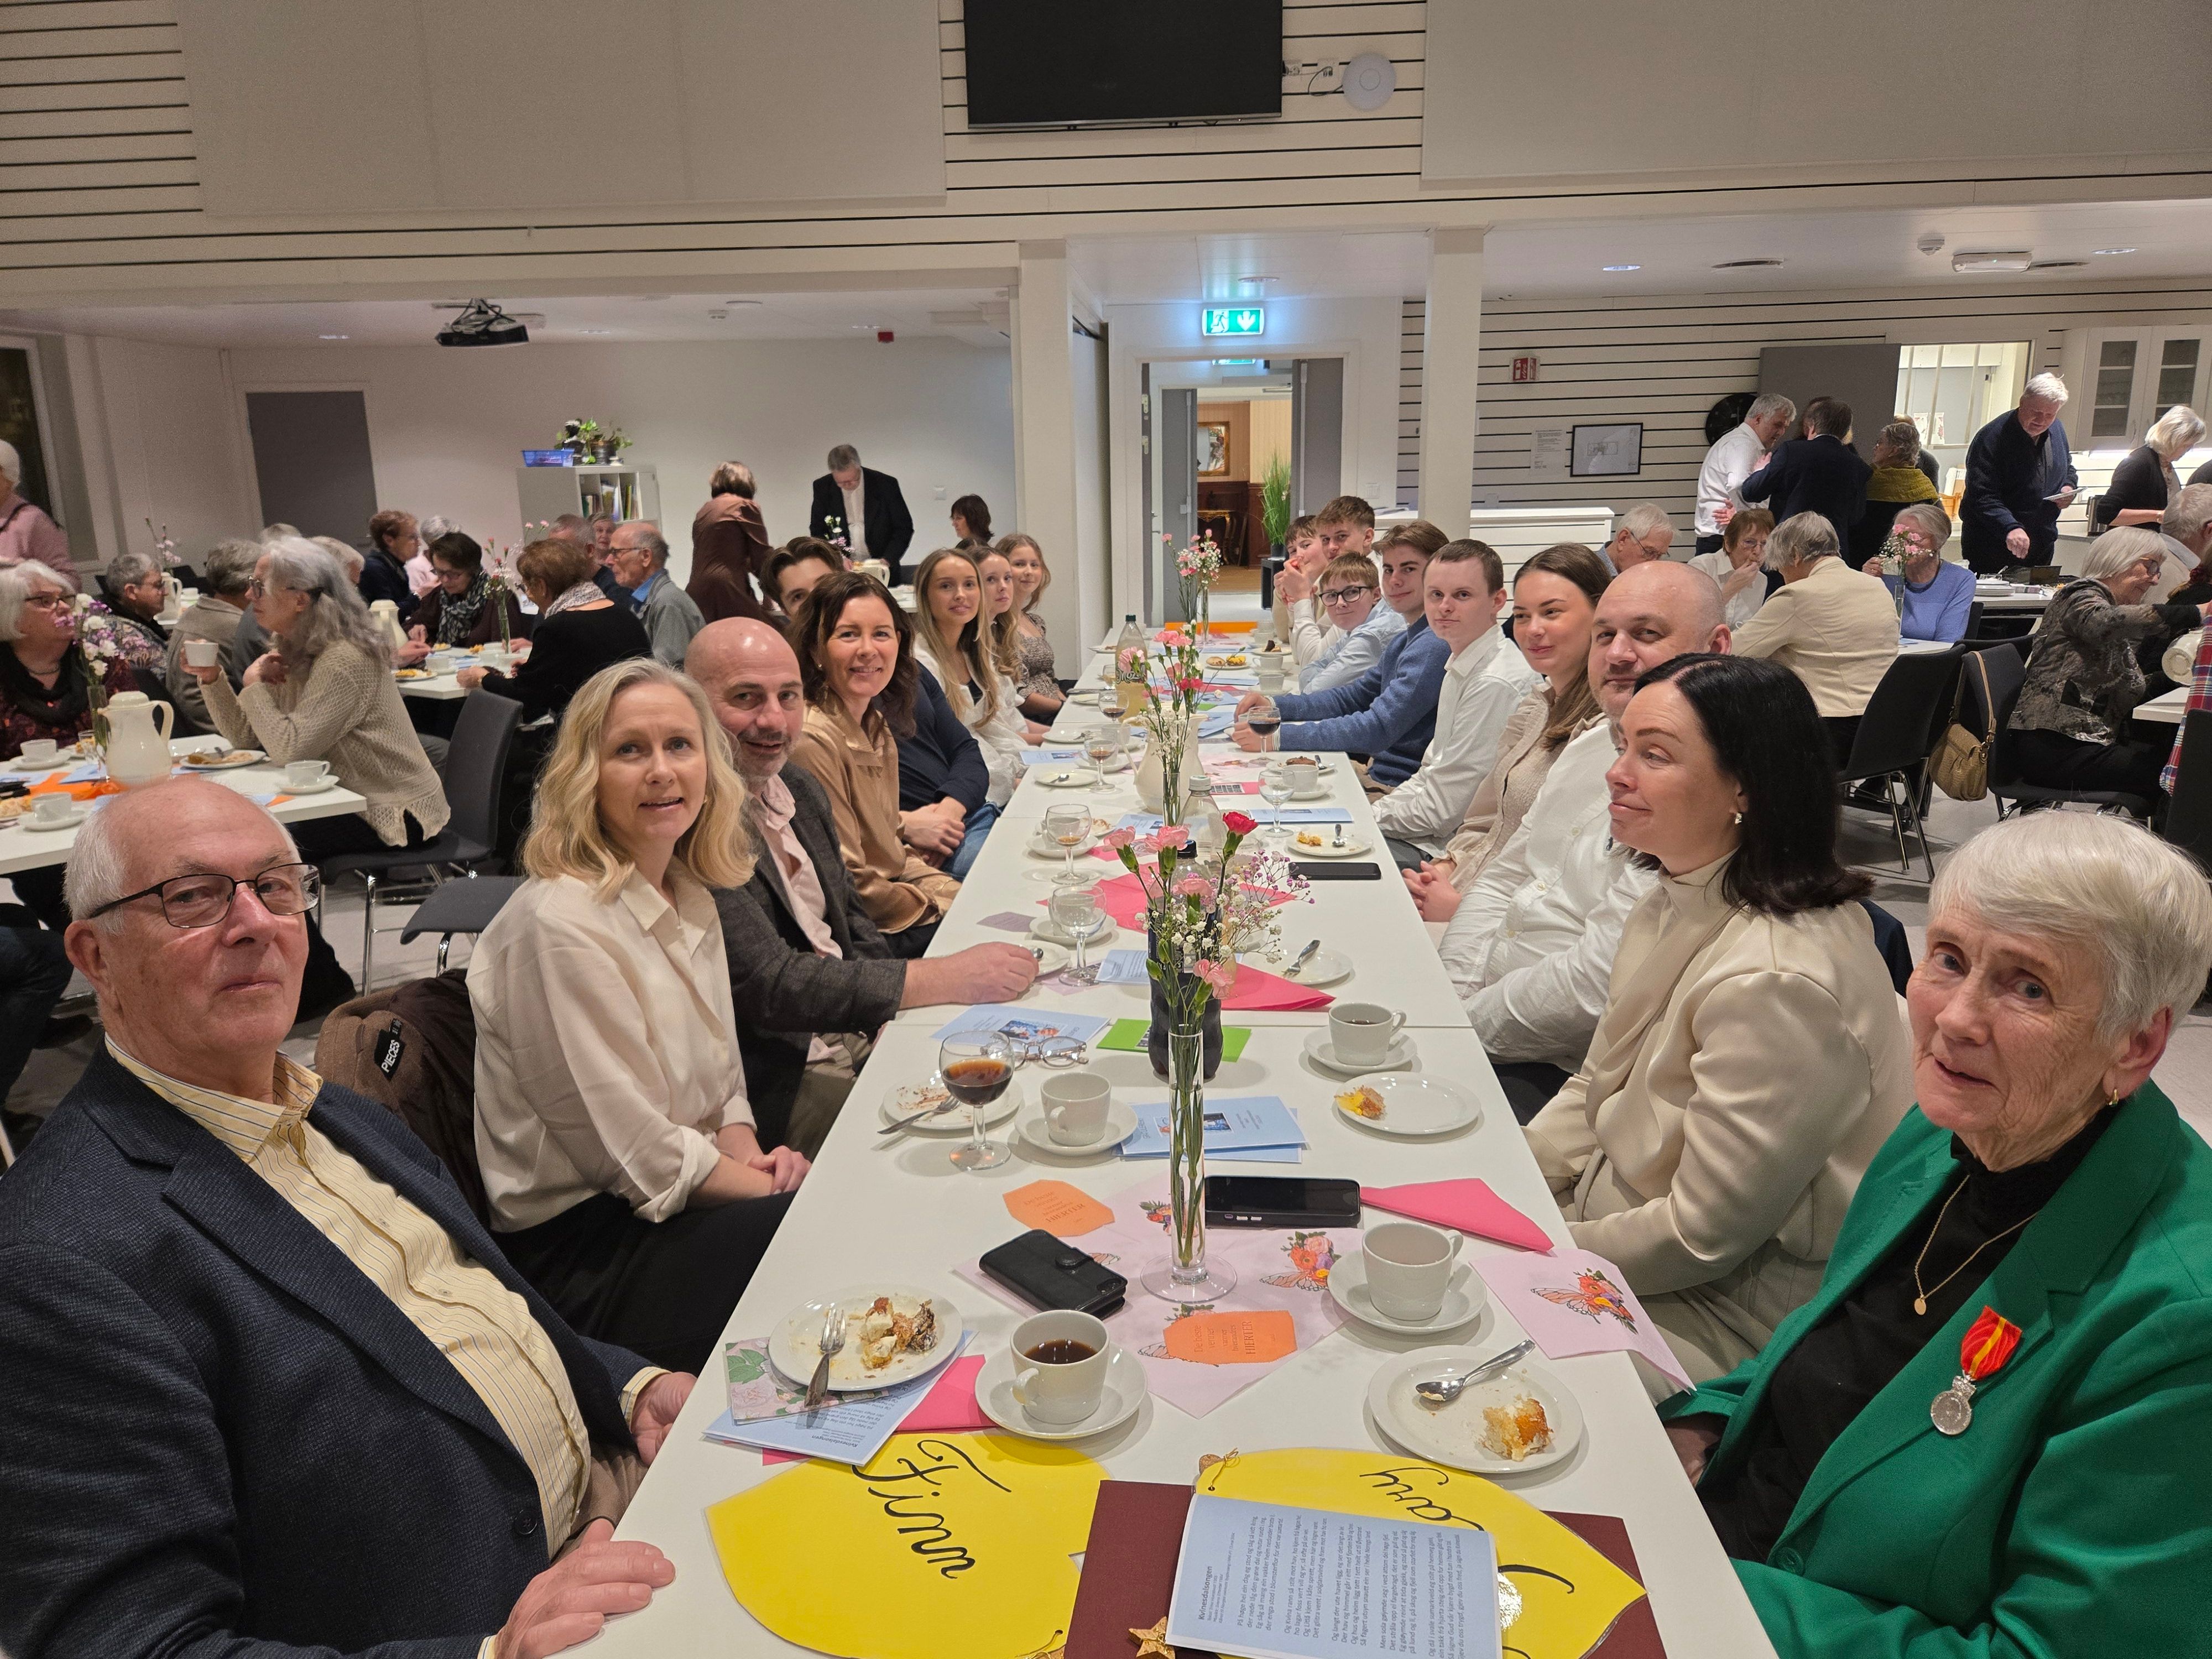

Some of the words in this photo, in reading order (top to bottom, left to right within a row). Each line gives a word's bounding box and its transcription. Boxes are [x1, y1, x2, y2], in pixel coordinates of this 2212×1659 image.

[381, 1039, 400, 1073] PIECES
[1193, 1325, 1202, 1341] beste
[1241, 1321, 1255, 1354] HJERTER
[1194, 1343, 1202, 1352] De
[812, 1434, 858, 1448] Kvinesdalsongen
[852, 1439, 1012, 1579] Finn
[1199, 1566, 1214, 1620] Kvinesdalsongen
[1238, 1604, 1246, 1618] høge
[1256, 1611, 1265, 1621] såg
[1284, 1625, 1292, 1633] Og
[1293, 1627, 1300, 1635] ho
[1303, 1628, 1311, 1636] Og
[1332, 1632, 1339, 1641] Og
[1352, 1636, 1358, 1644] Og
[1429, 1648, 1436, 1656] Og
